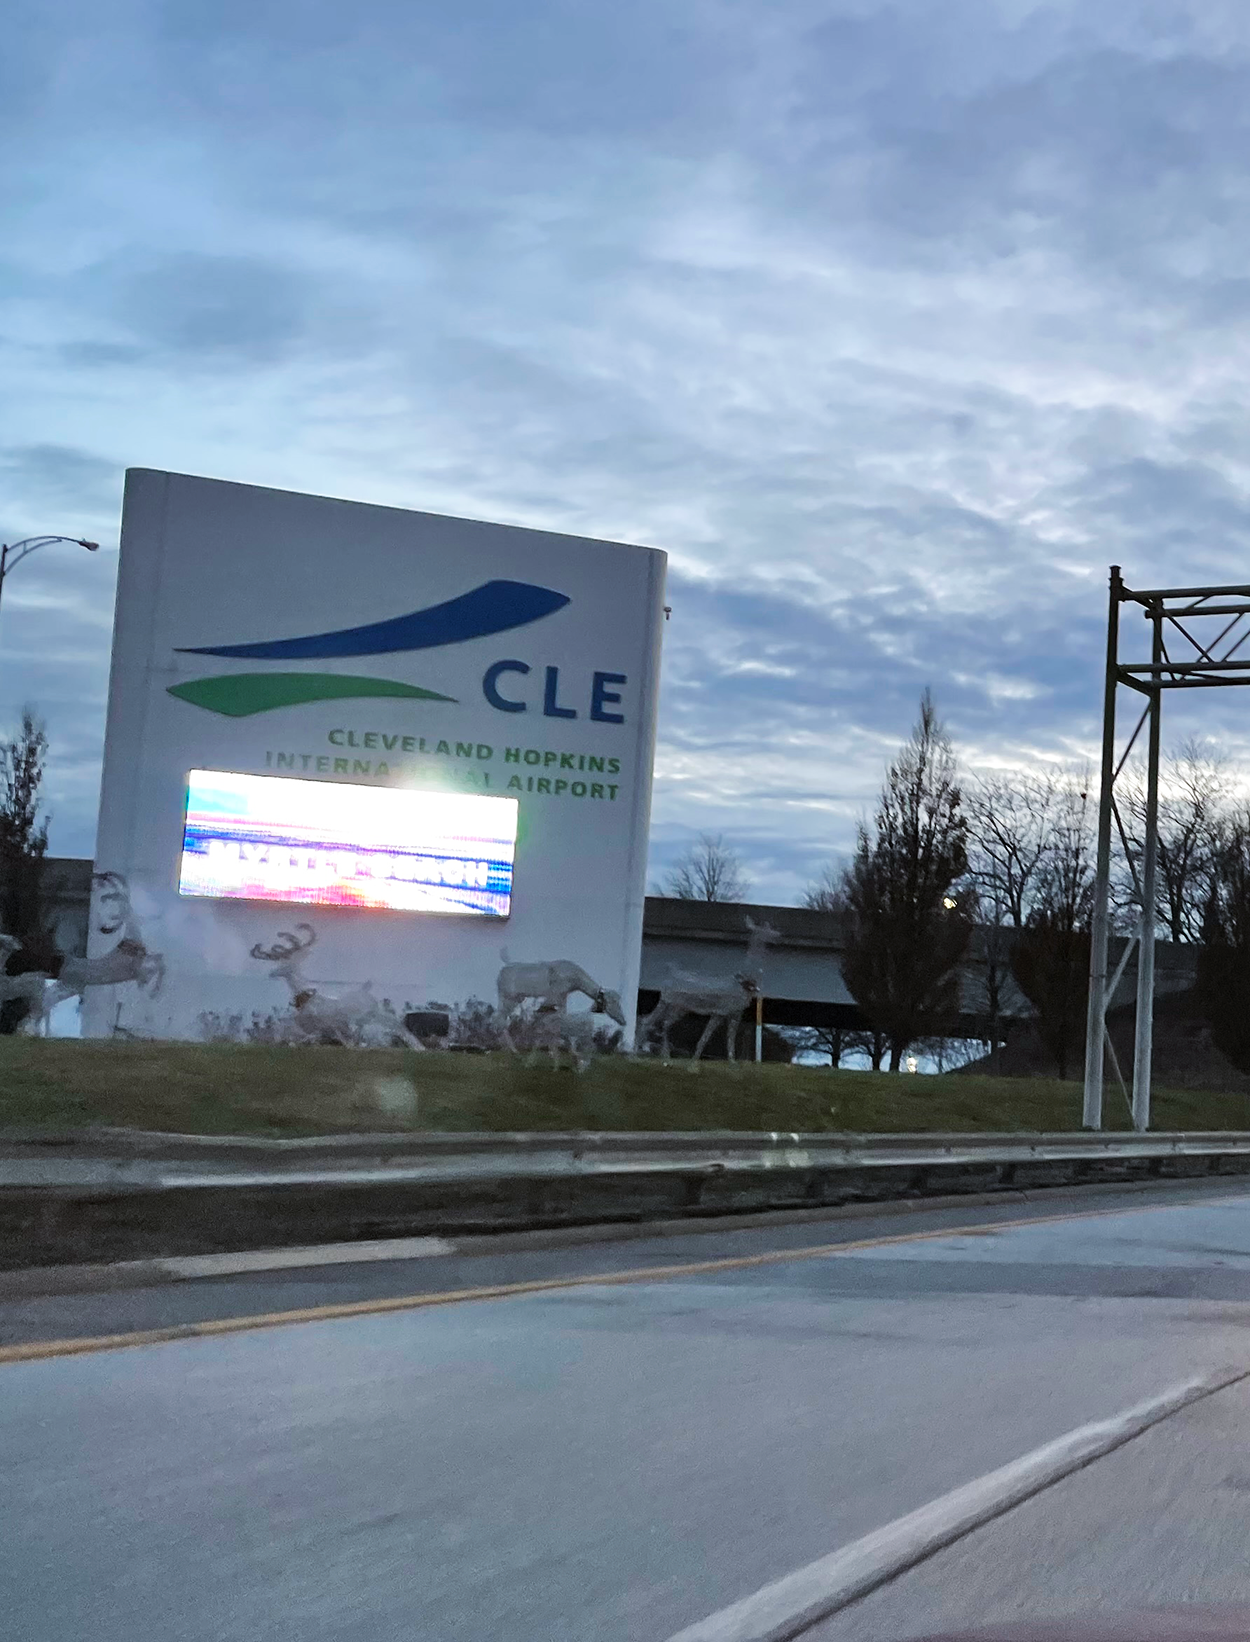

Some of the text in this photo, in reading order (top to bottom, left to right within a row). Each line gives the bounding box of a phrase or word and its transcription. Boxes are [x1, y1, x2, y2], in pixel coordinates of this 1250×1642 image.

[482, 659, 628, 725] CLE
[264, 750, 620, 801] INTERNAAL AIRPORT
[328, 728, 621, 775] CLEVELAND HOPKINS
